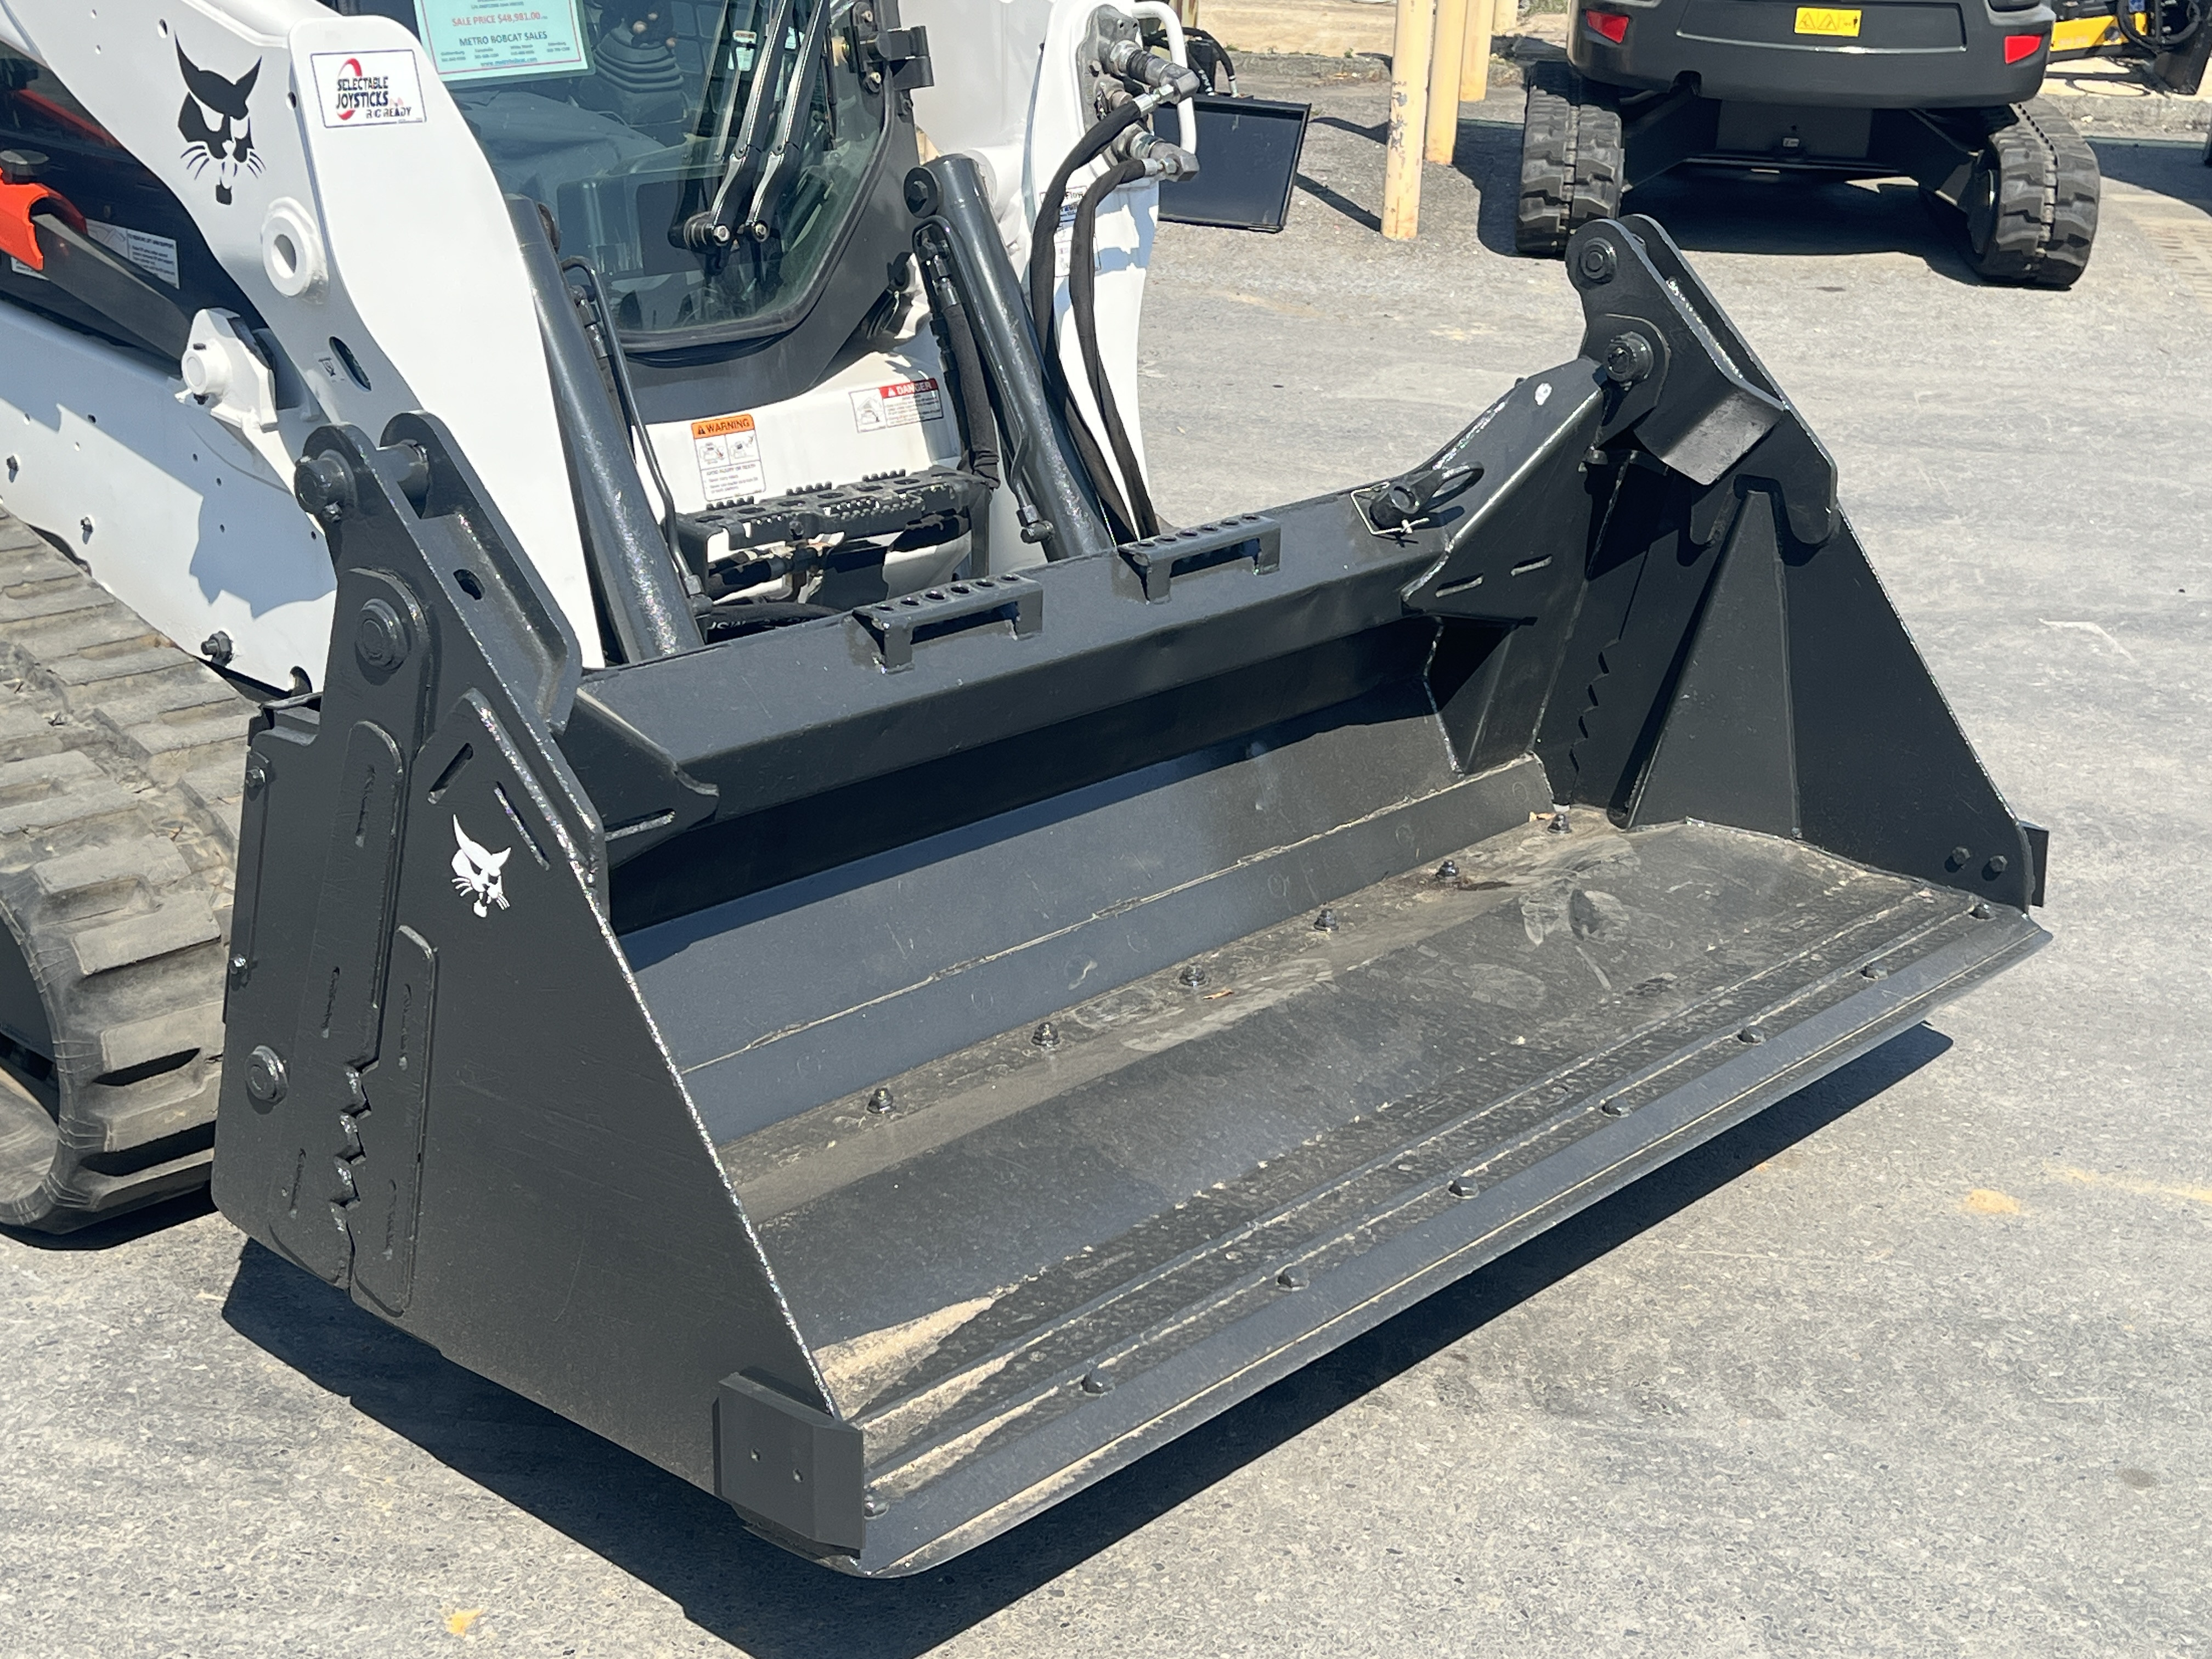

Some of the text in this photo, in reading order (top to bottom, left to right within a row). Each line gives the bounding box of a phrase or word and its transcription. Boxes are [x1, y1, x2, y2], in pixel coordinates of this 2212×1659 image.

[452, 16, 472, 27] SALE
[473, 15, 496, 24] PRICE
[459, 31, 548, 47] METRO BOBCAT SALES
[337, 76, 388, 91] SELECTABLE
[336, 91, 388, 109] JOYSTICKS
[383, 106, 412, 117] READY
[896, 382, 932, 396] DANGER
[706, 419, 750, 433] WARNING
